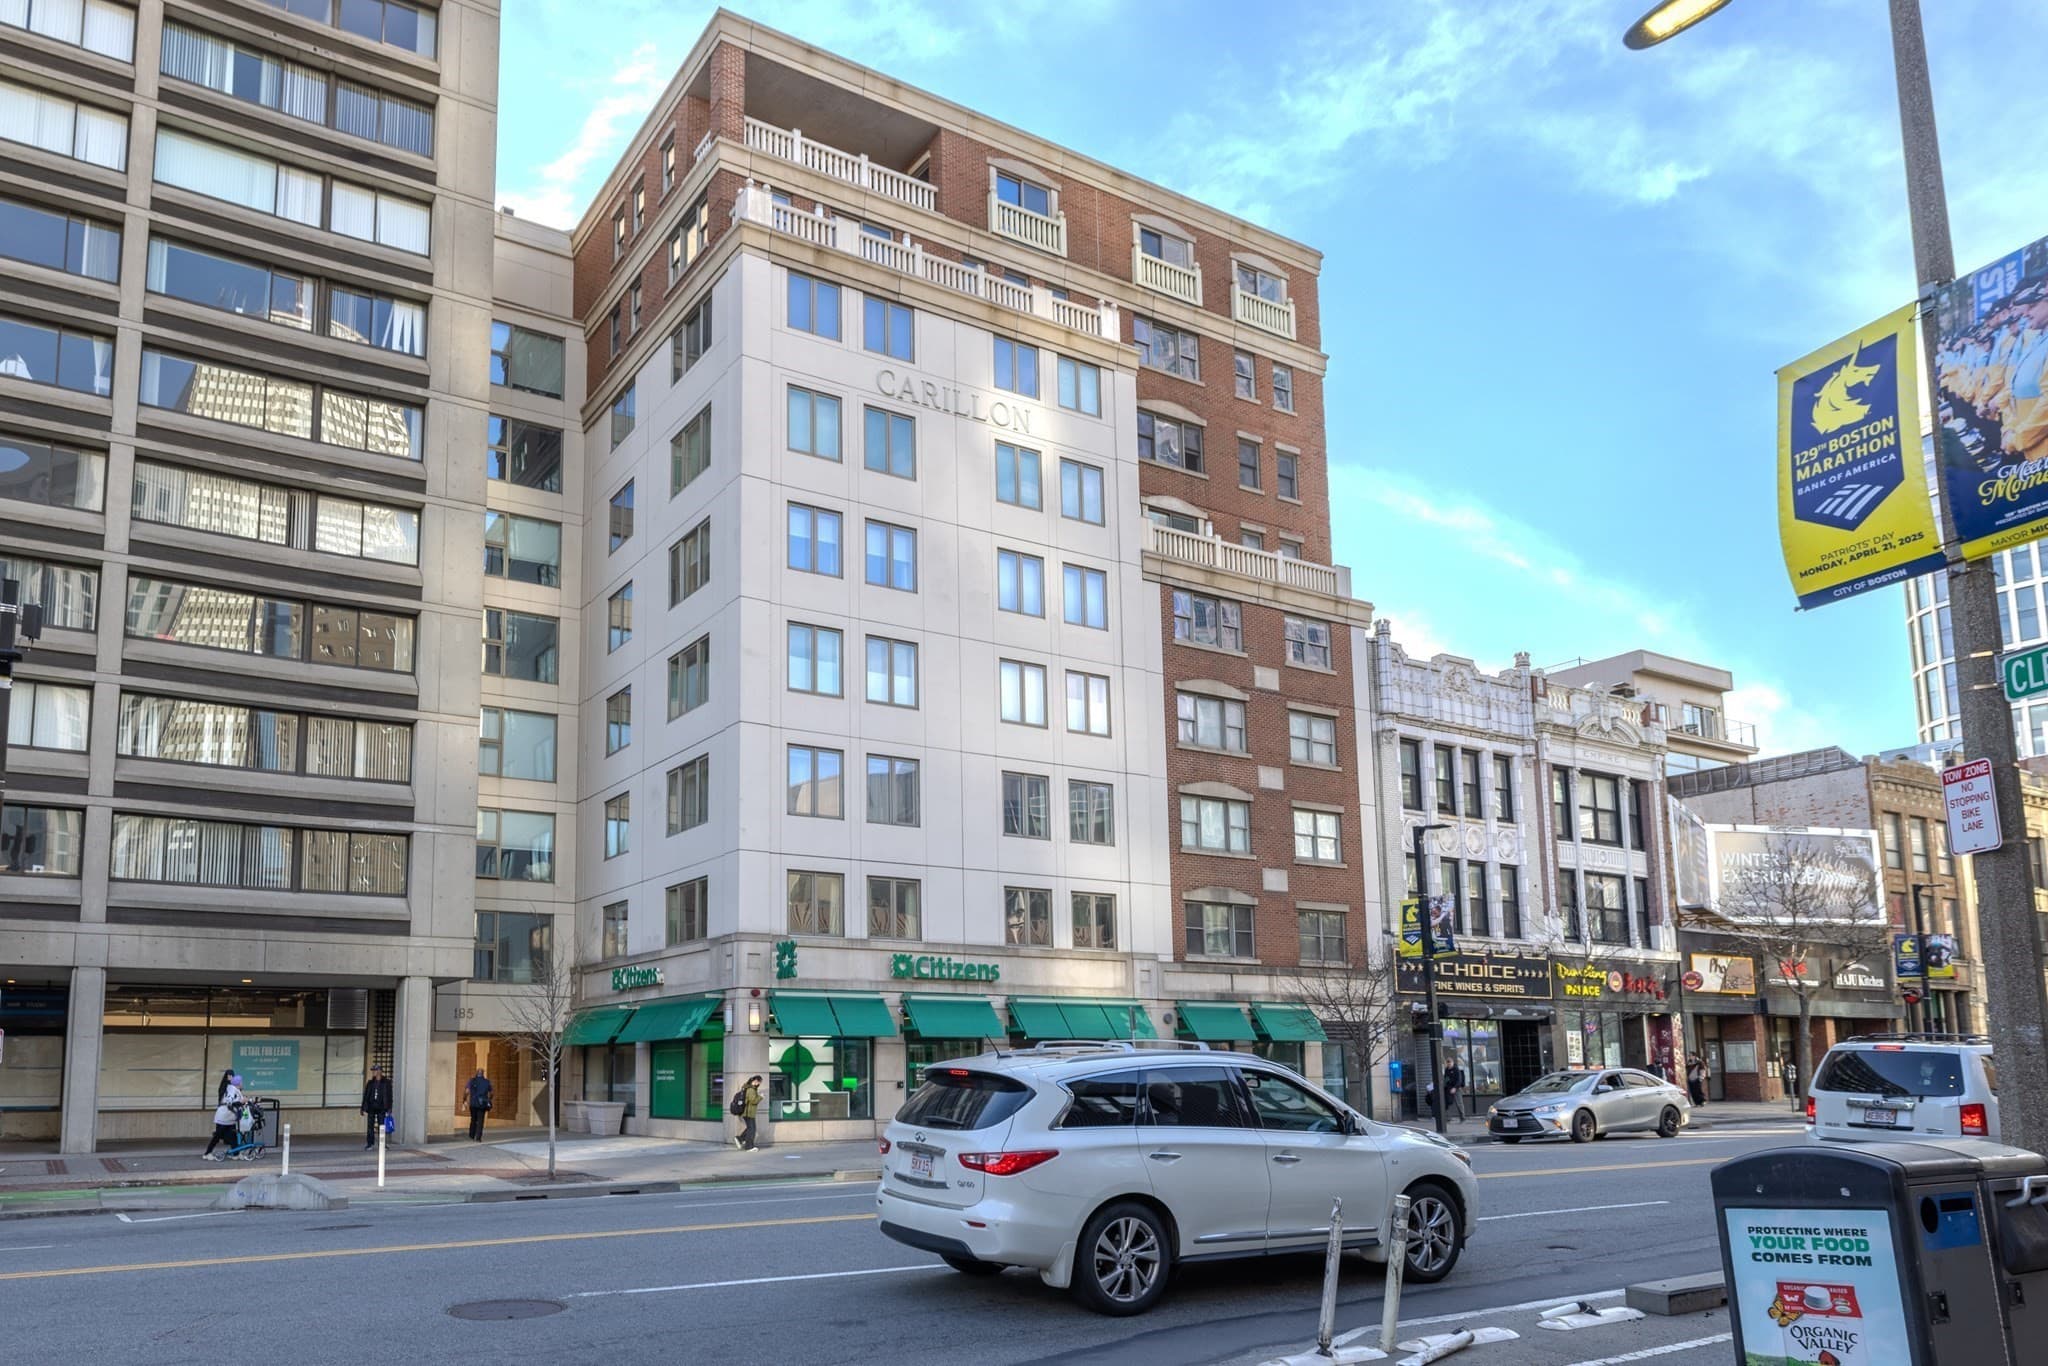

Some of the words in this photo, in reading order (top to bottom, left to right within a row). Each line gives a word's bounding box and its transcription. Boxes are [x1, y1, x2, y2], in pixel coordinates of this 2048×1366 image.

[876, 369, 1031, 433] CARILLON
[1829, 416, 1894, 452] BOSTON
[1797, 432, 1896, 482] MARATHON
[1797, 479, 1826, 496] BANK
[1828, 473, 1843, 485] OF
[1845, 453, 1897, 478] AMERICA
[1997, 458, 2042, 481] Meet
[1873, 531, 1895, 544] DAY
[1990, 530, 2029, 547] MAYOR
[1800, 559, 1847, 579] MONDAY,
[1849, 547, 1880, 562] APRIL
[1882, 541, 1897, 552] 21,
[1899, 531, 1925, 547] 2025
[1833, 584, 1852, 597] CITY
[1853, 581, 1866, 592] OF
[1868, 569, 1908, 587] BOSTON
[1944, 769, 1962, 783] TOW
[1965, 762, 1989, 778] ZONE
[1961, 782, 1974, 793] NO
[1950, 791, 1990, 809] STOPPING
[1961, 806, 1981, 820] BIKE
[1962, 819, 1984, 833] LANE
[1721, 852, 1780, 868] WINTER
[620, 966, 657, 989] Citizens
[916, 956, 1000, 981] Citizens
[1440, 961, 1516, 979] CHOICE
[1456, 982, 1483, 992] WINES
[1484, 983, 1491, 992] &
[1493, 984, 1525, 994] SPIRITS
[454, 1007, 474, 1019] 185
[1747, 1226, 1821, 1236] PROTECTING
[1823, 1228, 1869, 1237] WHERE
[1749, 1235, 1807, 1250] YOUR
[1811, 1237, 1871, 1253] FOOD
[1751, 1252, 1814, 1264] COMES
[1817, 1254, 1873, 1267] FROM
[1790, 1325, 1858, 1345] ORGANIC
[1798, 1337, 1854, 1354] VALLEY
